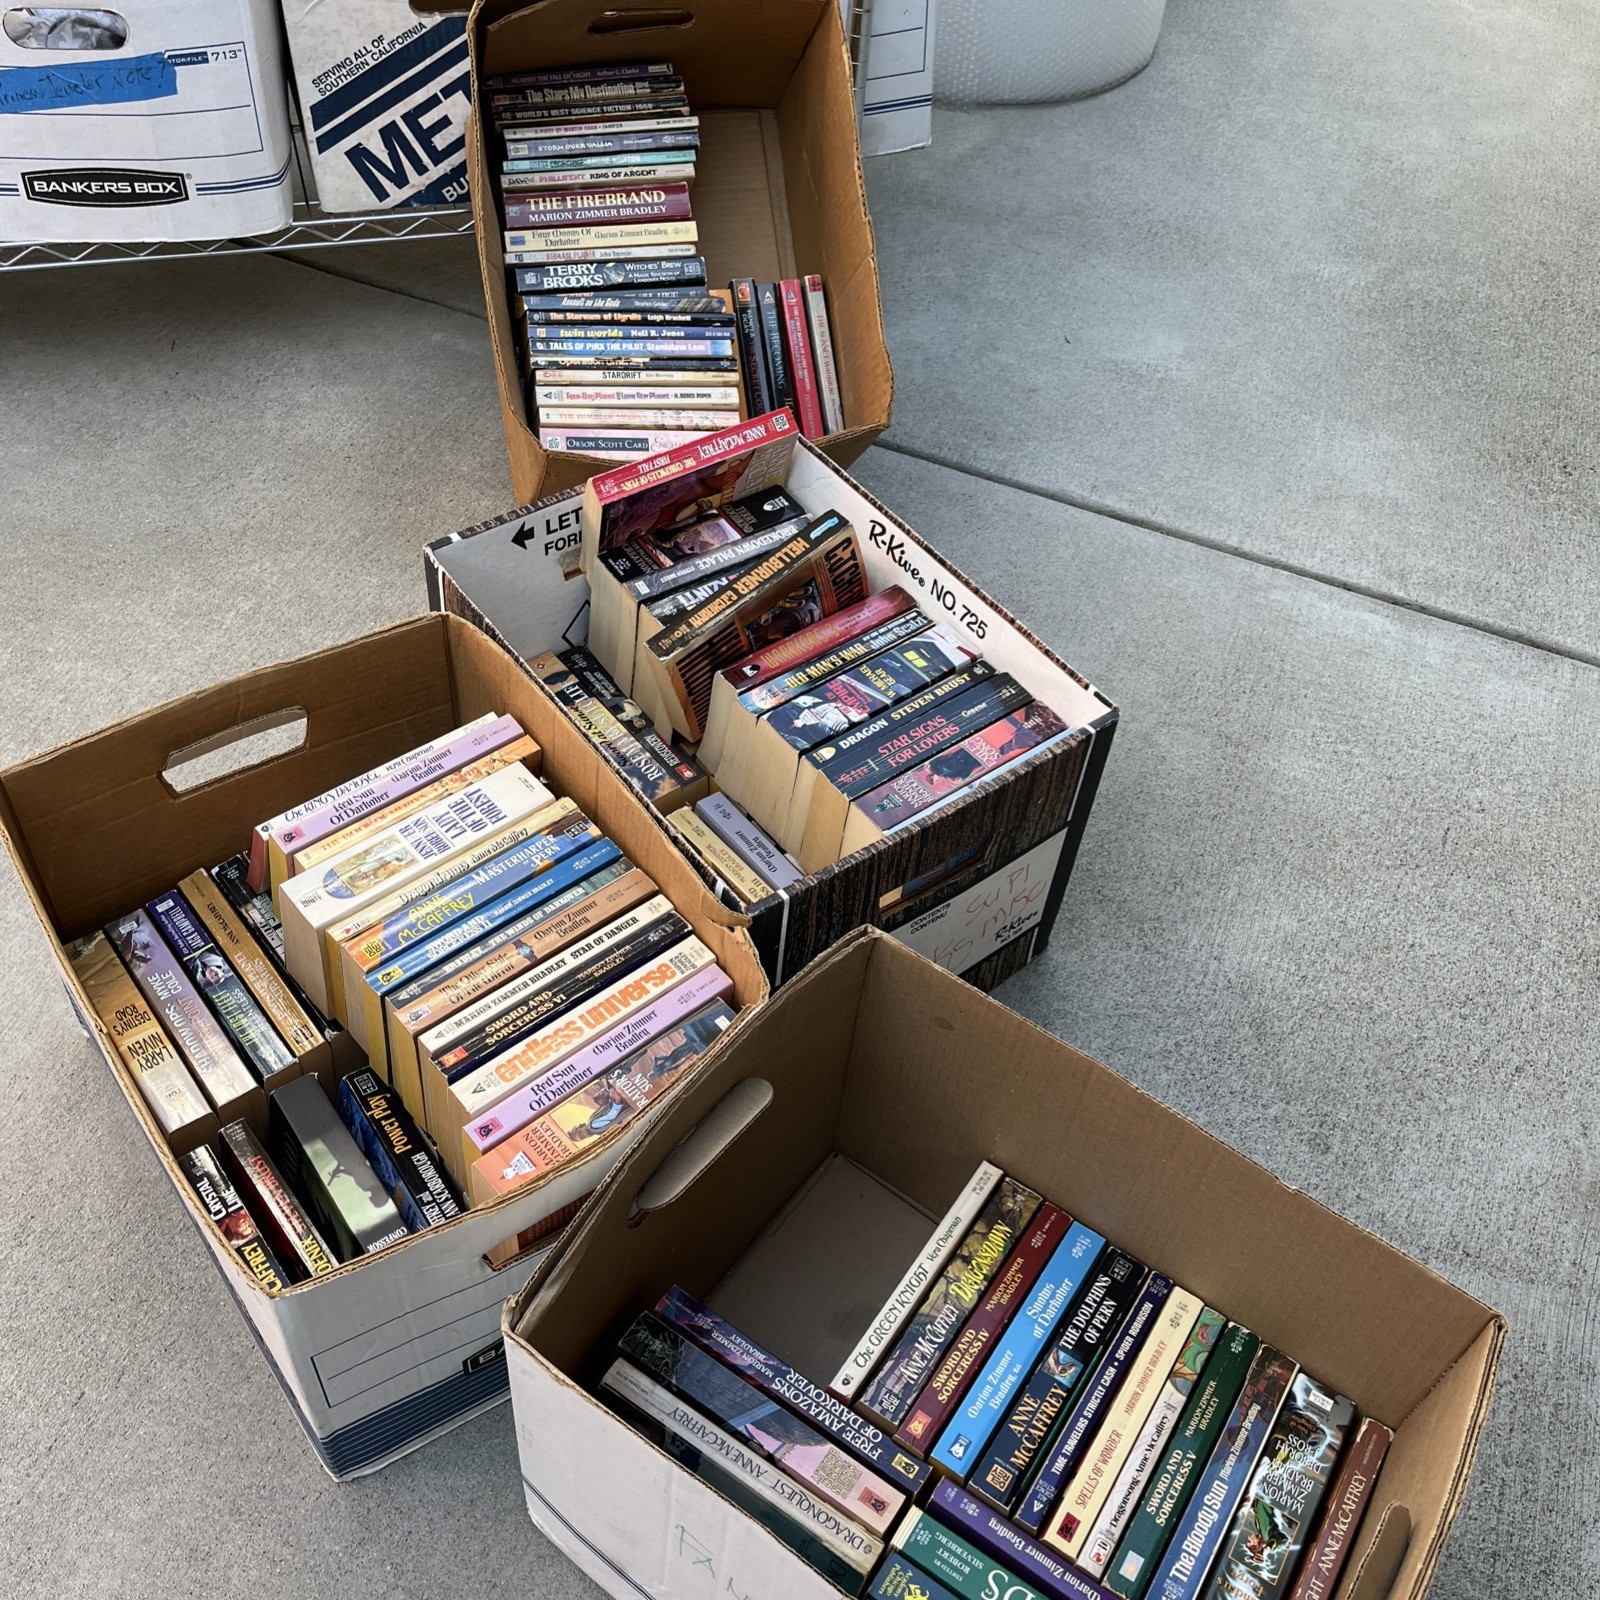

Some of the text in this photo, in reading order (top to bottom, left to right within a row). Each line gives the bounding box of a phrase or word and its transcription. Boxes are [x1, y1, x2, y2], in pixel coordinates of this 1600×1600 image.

[312, 35, 385, 88] SERVING ALL OF
[318, 21, 427, 96] SOUTHERN CALIFORNIA
[544, 83, 634, 102] Stars Destination
[516, 106, 601, 119] WORLD'S SCIENCE
[33, 180, 179, 194] BANKERS BOX
[442, 175, 469, 202] BU
[526, 190, 665, 211] THE FIREBRAND
[529, 205, 667, 222] MARION ZIMMER BRADLEY
[542, 274, 603, 288] BROOKS
[545, 263, 597, 276] TERRY
[625, 262, 659, 271] WITCHES'
[549, 342, 573, 350] TALES
[575, 342, 585, 350] OF
[586, 342, 605, 350] PIRX
[560, 329, 584, 337] twin
[587, 329, 623, 337] worlds
[567, 439, 595, 447] ORSON
[598, 440, 622, 448] SCOTT
[742, 424, 767, 444] ANNE
[698, 525, 799, 571] BROKEDOWN PALACE
[732, 537, 810, 595] HELLBURNER
[931, 578, 956, 615] NO.
[960, 604, 988, 639] 725
[785, 643, 870, 689] OLD MAN'S WAR
[859, 664, 888, 692] MICHAEL
[876, 667, 897, 686] GEAR
[838, 672, 972, 749] DRAGON STEVEN BRUST
[606, 723, 663, 781] ROSEMARY
[643, 733, 681, 766] REDISCOVERY
[877, 716, 948, 757] STAR SIGNS
[889, 724, 960, 768] FOR LOVERS
[973, 736, 1002, 760] SONG
[448, 798, 488, 832] OF THE
[464, 788, 508, 825] FOREST
[432, 811, 467, 839] LADY
[471, 834, 558, 885] MASTERHARPER
[531, 845, 561, 869] PERN
[169, 905, 199, 935] CAMPBELL
[398, 892, 475, 945] McCAFFREY
[408, 893, 446, 923] ANNE
[910, 903, 951, 928] CONTENTS
[910, 911, 948, 934] CONTENU
[147, 972, 172, 1001] MYKE
[162, 969, 184, 995] COLE
[454, 916, 640, 1029] MARION ZIMMER BRADLEY STAR OF DANGER
[112, 1012, 152, 1037] DESTINY'S
[115, 1003, 139, 1021] ROAD
[485, 990, 553, 1034] SWORD AND
[485, 993, 567, 1046] SORCERESS VI
[494, 961, 678, 1084] endless universe
[622, 1009, 659, 1035] Zimmer
[127, 1031, 164, 1057] NIVEN
[617, 1028, 651, 1054] Bradley
[137, 1045, 174, 1073] LARRY
[529, 1063, 577, 1096] Red Sun
[529, 1066, 595, 1113] Of Darkover
[632, 1072, 653, 1093] SUN
[367, 1093, 412, 1155] Power Play
[411, 1151, 452, 1203] SCARBOROUGH
[196, 1177, 226, 1221] CRYSTAL
[217, 1187, 243, 1213] LINE
[853, 1216, 962, 1369] The GREEN KNIGHT Vera Chapman
[901, 1220, 1013, 1384] ANNE McCAFFREY DRAGONSDAWN
[932, 1257, 1024, 1392] SWORD AND MARION ZIMMER
[1058, 1273, 1112, 1351] THE DOLPHINS
[1083, 1297, 1118, 1344] OF PERN
[937, 1273, 1024, 1404] SORCERESS IV BRADLEY
[991, 1349, 1014, 1384] Zimmer
[786, 1368, 883, 1443] OF DARKOVER
[1051, 1301, 1154, 1475] TIME TRAVELERS STRICTLY CASH SPIDER ROBINSON
[771, 1377, 883, 1461] FREE AMAZONS
[1008, 1393, 1040, 1438] ANNE
[1010, 1383, 1069, 1471] McCAFFREY
[669, 1406, 866, 1551] DRAGONQUEST ANNE McCAFFREY
[1075, 1474, 1098, 1510] SPELLS
[1146, 1449, 1184, 1516] SWORD AND
[1155, 1463, 1192, 1527] SORCERESS
[1261, 1481, 1305, 1515] MARION
[989, 1517, 1030, 1551] Bradley
[1169, 1479, 1229, 1583] The Bloody Sun
[933, 1530, 985, 1570] SILVERBERG
[935, 1548, 971, 1575] ROBERT
